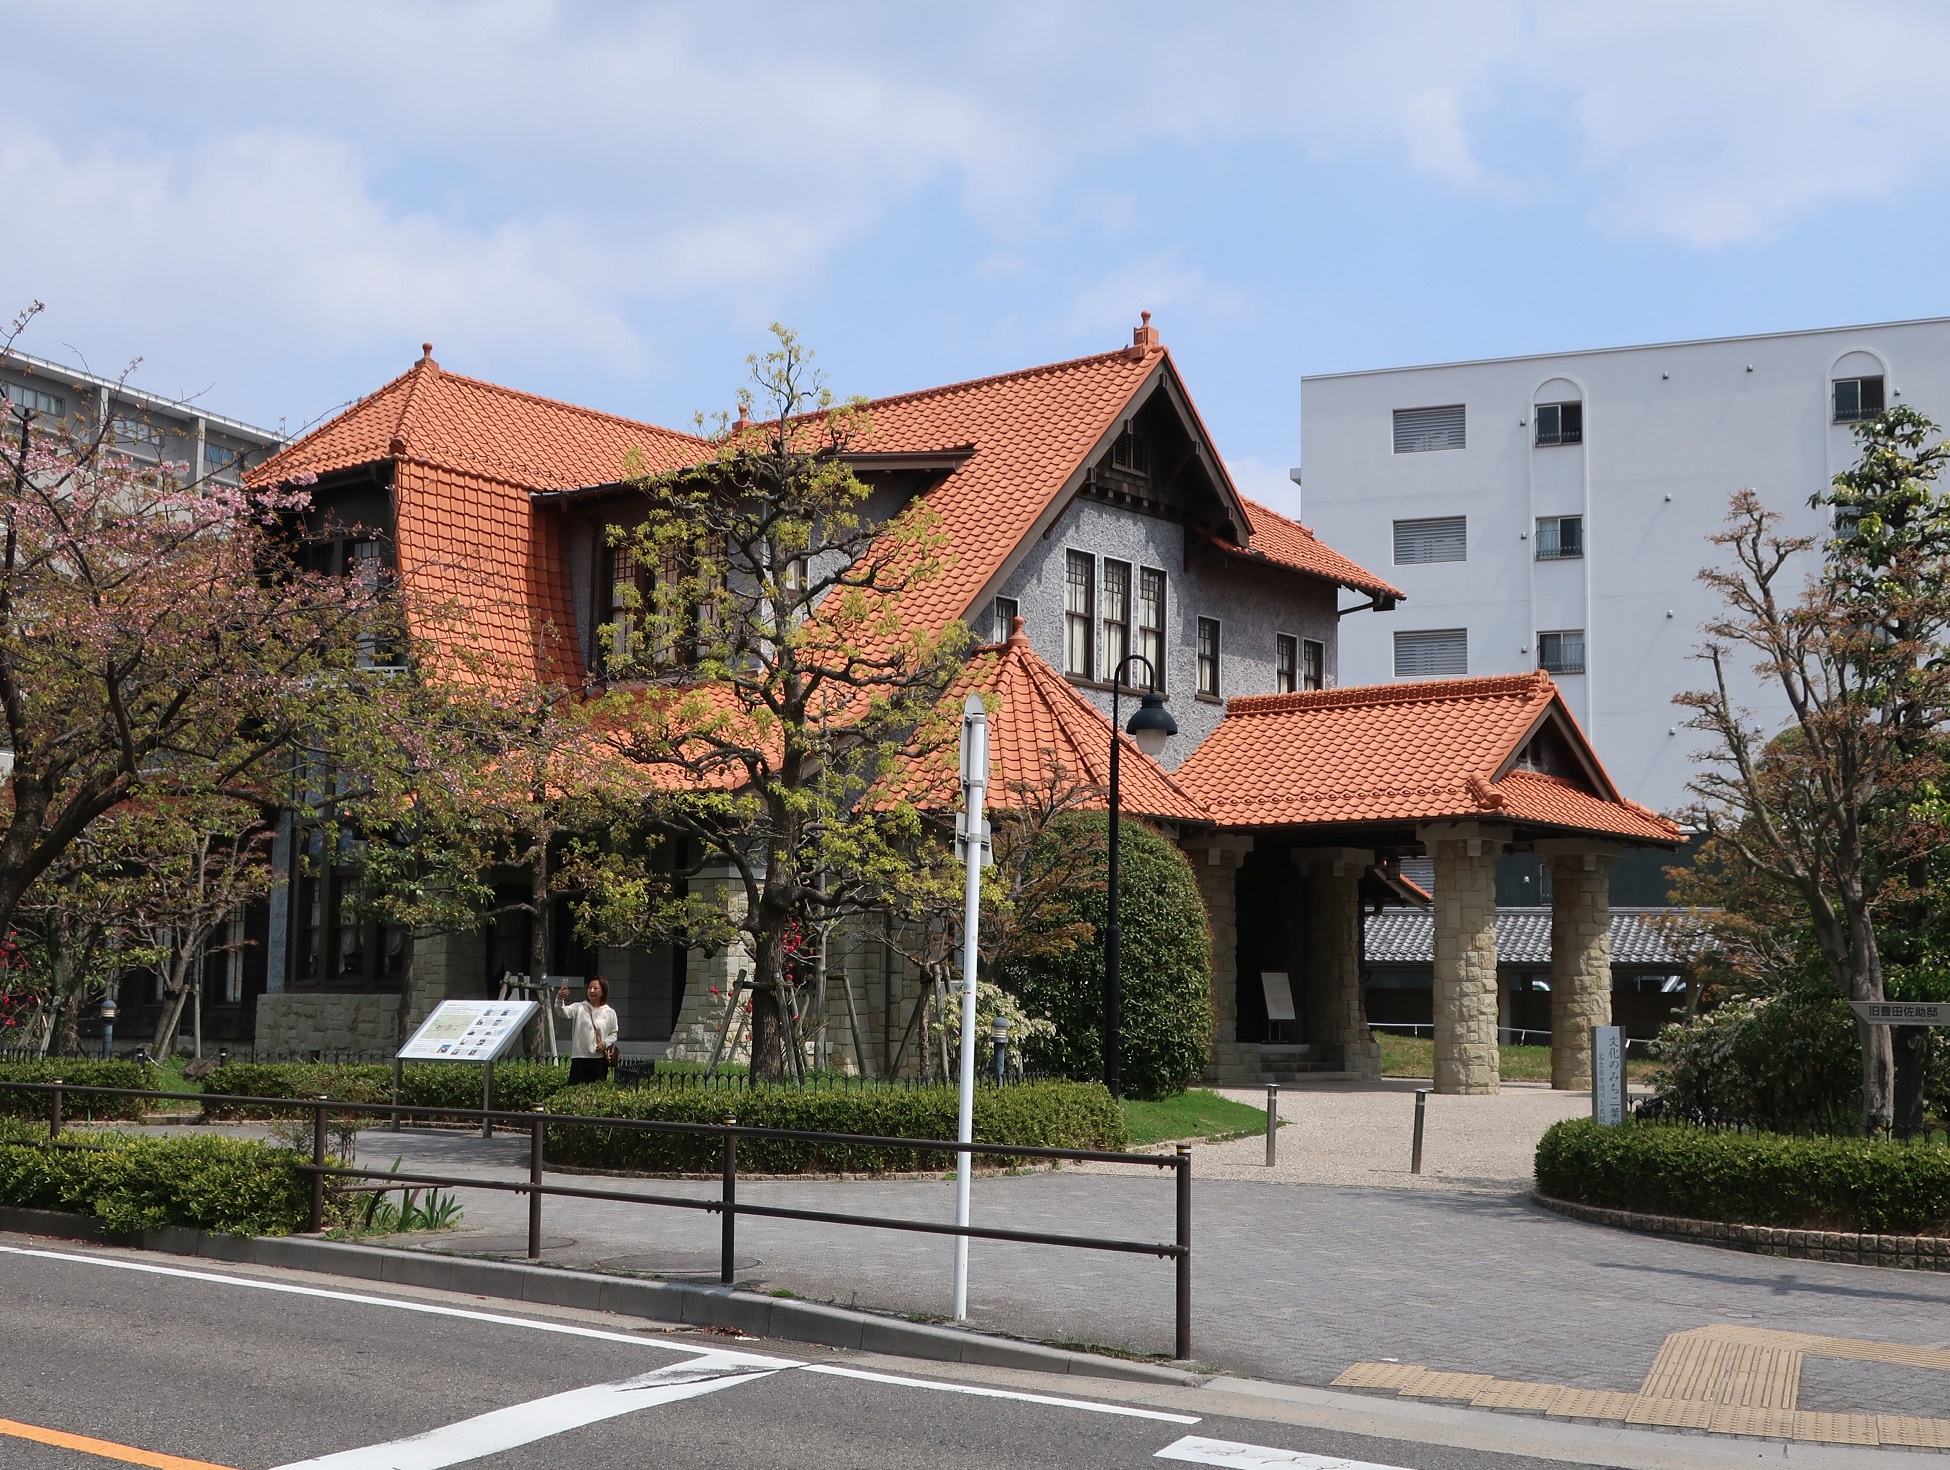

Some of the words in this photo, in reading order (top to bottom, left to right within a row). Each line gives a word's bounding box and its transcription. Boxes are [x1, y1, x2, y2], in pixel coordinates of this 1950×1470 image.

[1869, 1006, 1938, 1017] 旧豊田佐助邸
